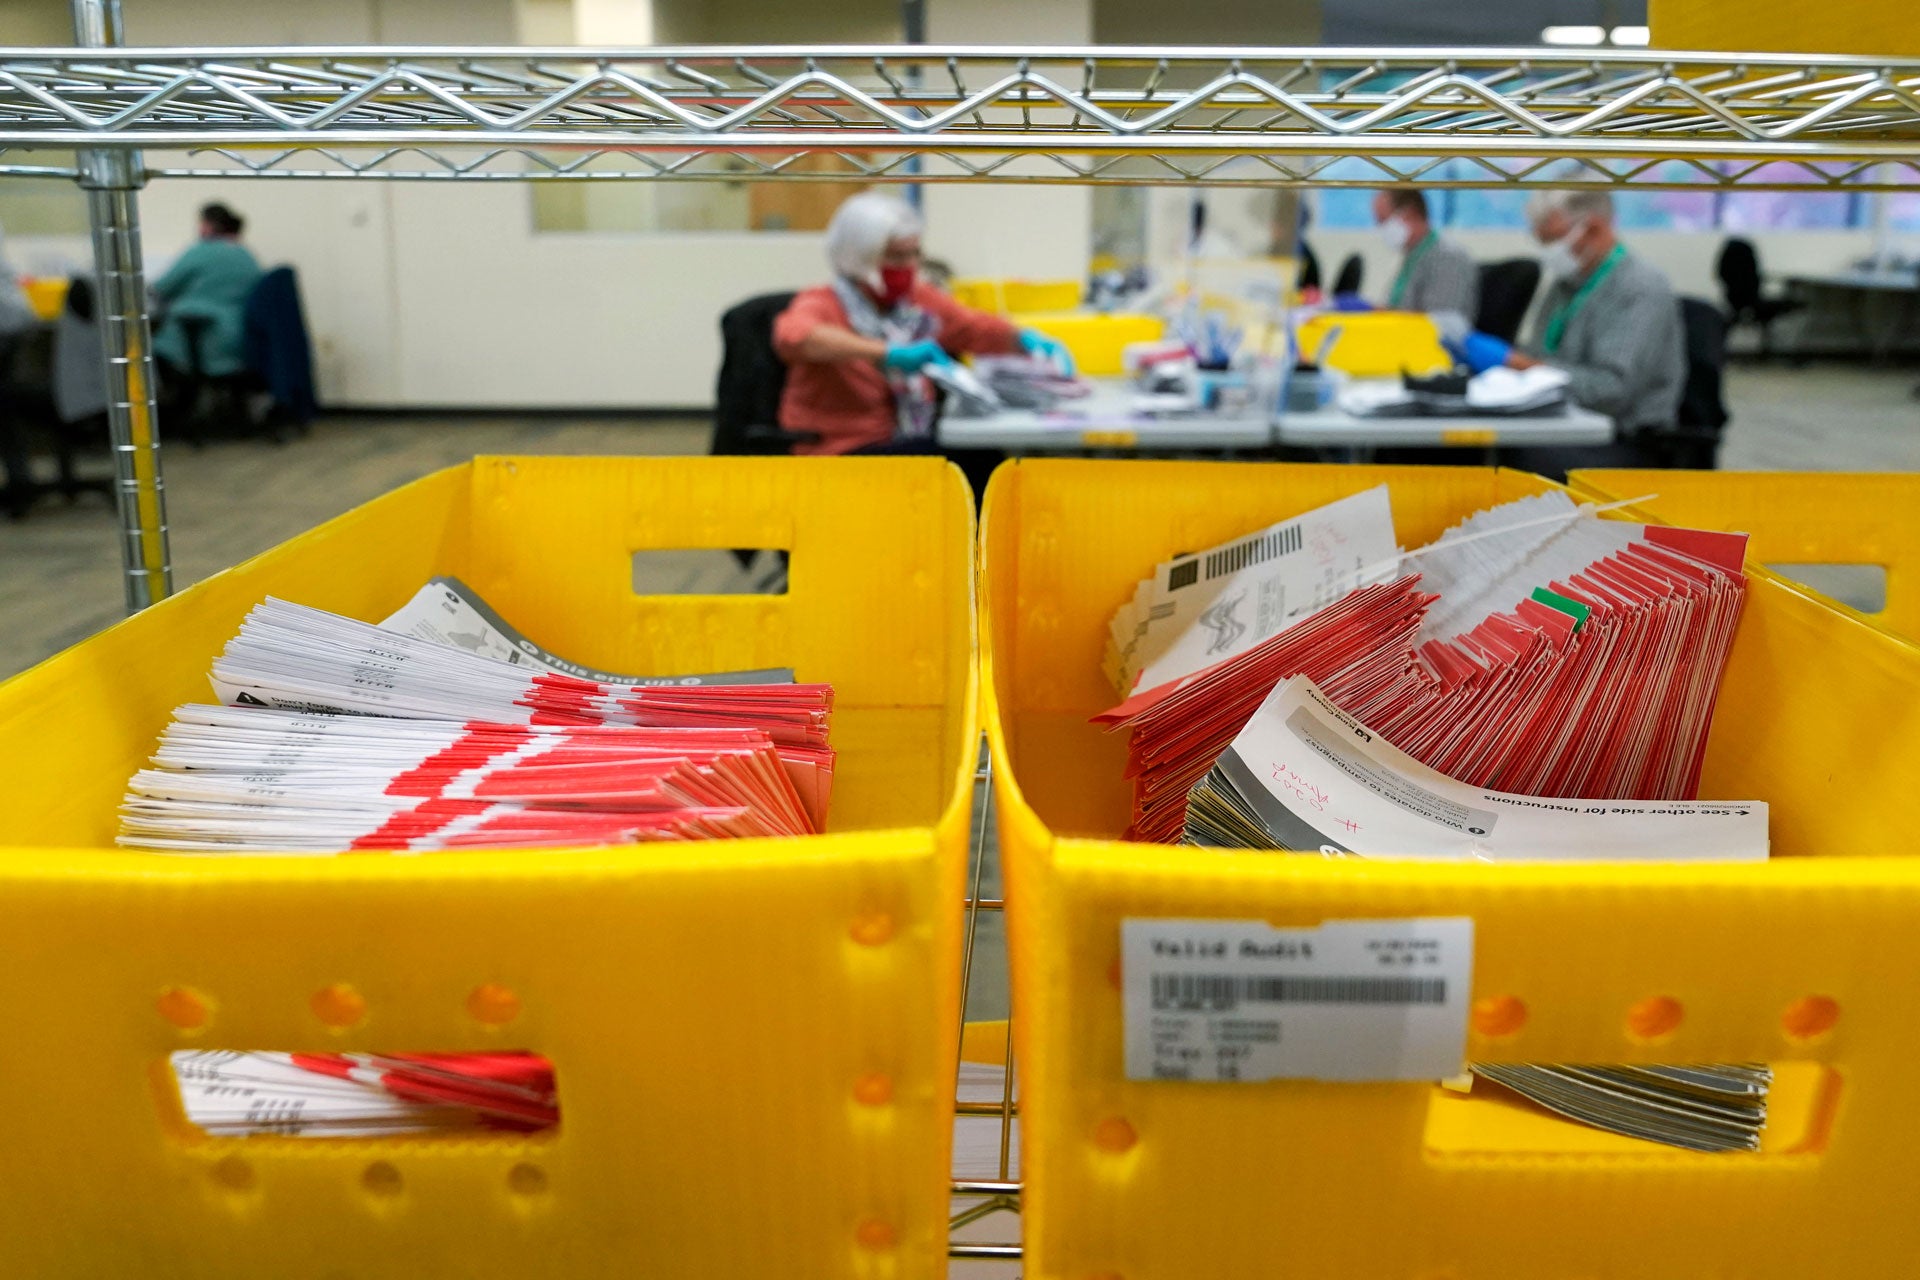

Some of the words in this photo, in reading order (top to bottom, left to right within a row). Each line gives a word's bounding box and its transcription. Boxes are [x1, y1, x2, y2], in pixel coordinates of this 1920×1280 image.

[544, 652, 589, 676] This
[594, 673, 639, 685] end
[1306, 689, 1334, 715] County
[1335, 714, 1355, 730] King
[1306, 739, 1367, 783] campaigns?
[1369, 783, 1381, 792] to
[1384, 791, 1432, 817] donates
[1484, 795, 1578, 814] instructions
[1583, 805, 1607, 815] for
[1611, 807, 1645, 815] side
[1649, 808, 1695, 816] other
[1435, 816, 1463, 829] Who
[1152, 938, 1227, 958] Valid
[1239, 938, 1313, 959] Audit
